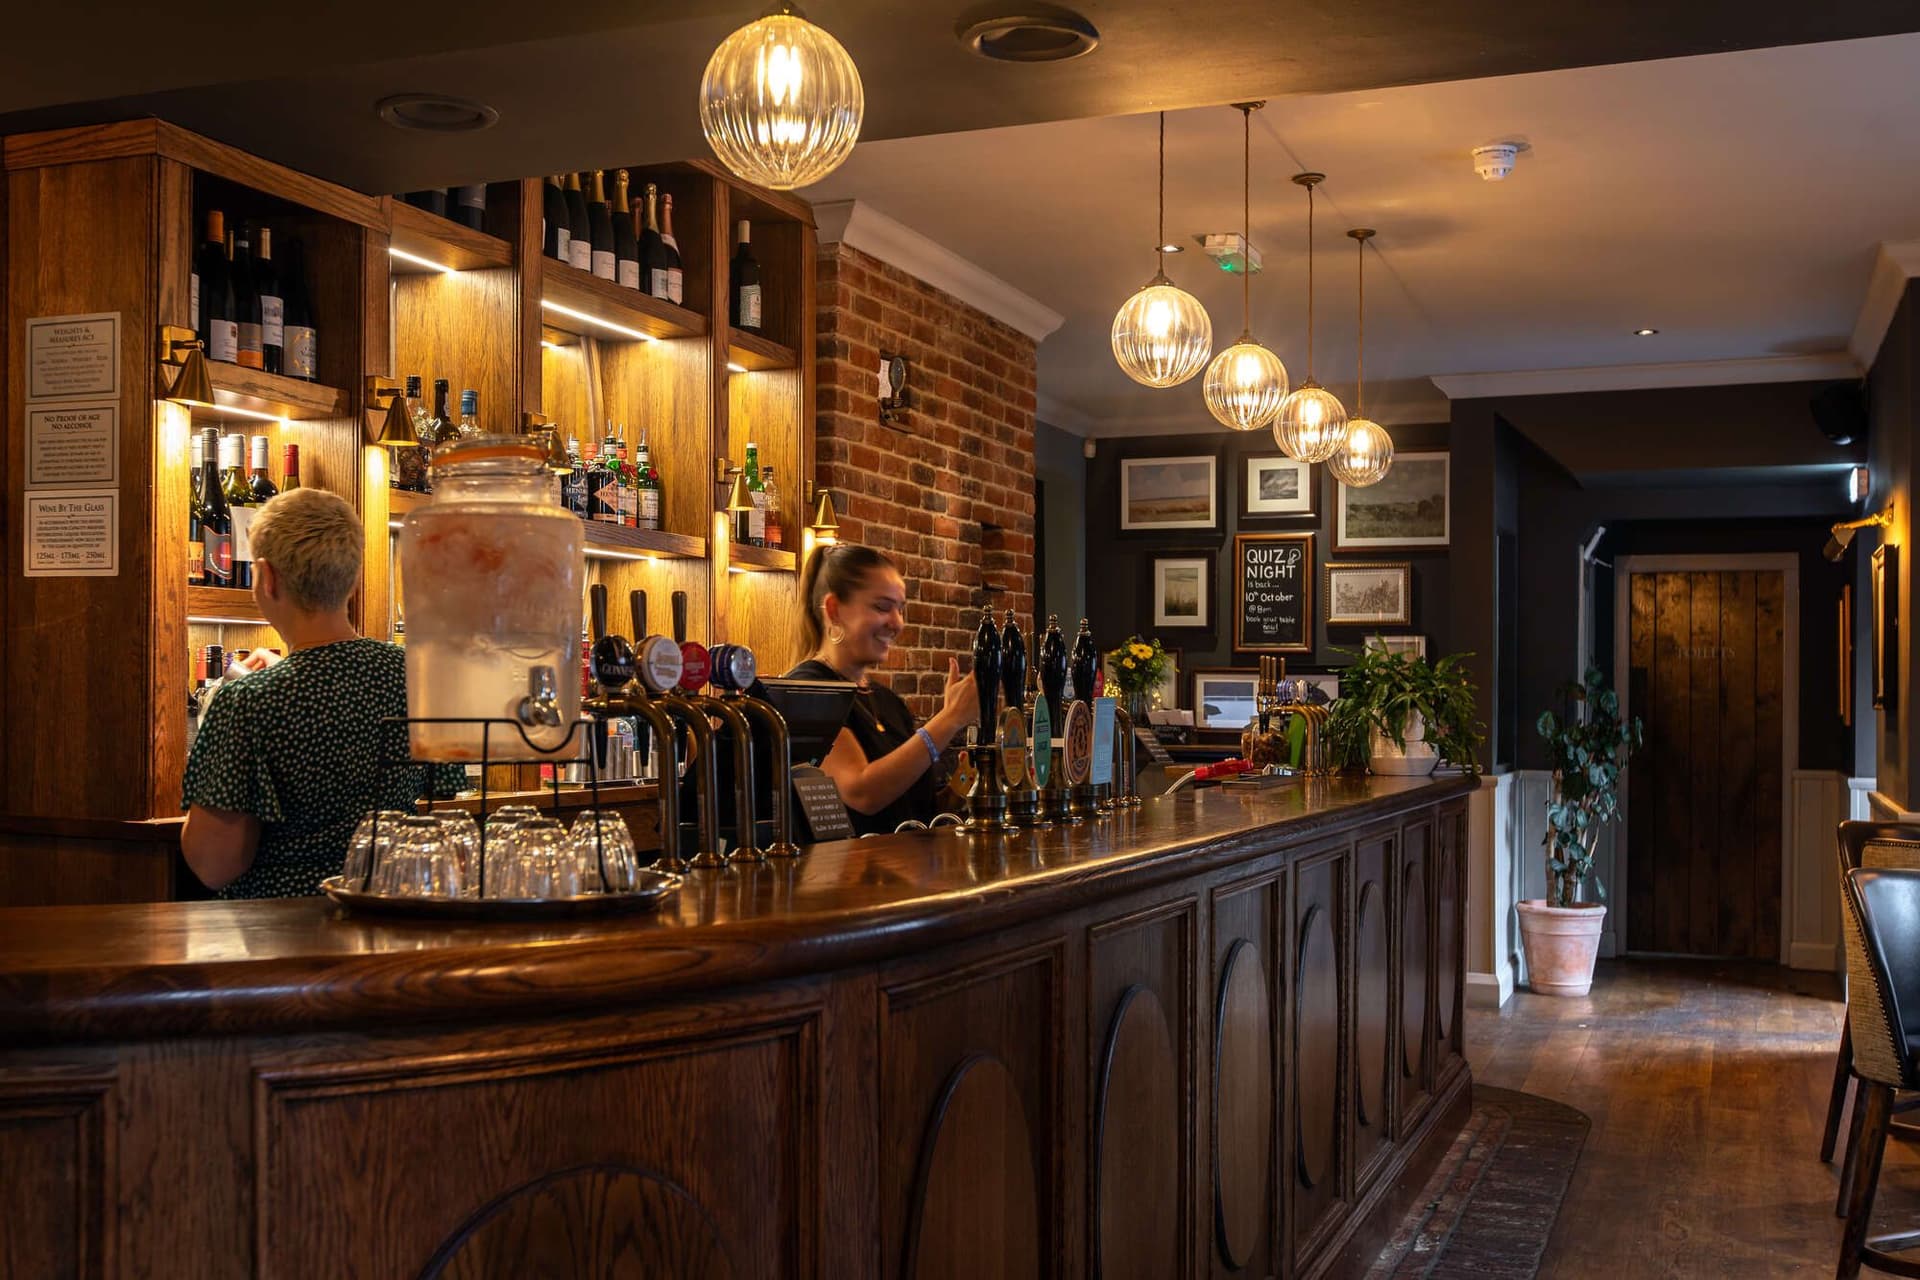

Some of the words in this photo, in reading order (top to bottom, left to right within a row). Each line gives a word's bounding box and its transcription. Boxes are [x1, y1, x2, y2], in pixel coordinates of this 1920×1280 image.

[1246, 549, 1286, 564] QUIZ
[1246, 565, 1296, 579] NIGHT
[1260, 591, 1294, 602] October
